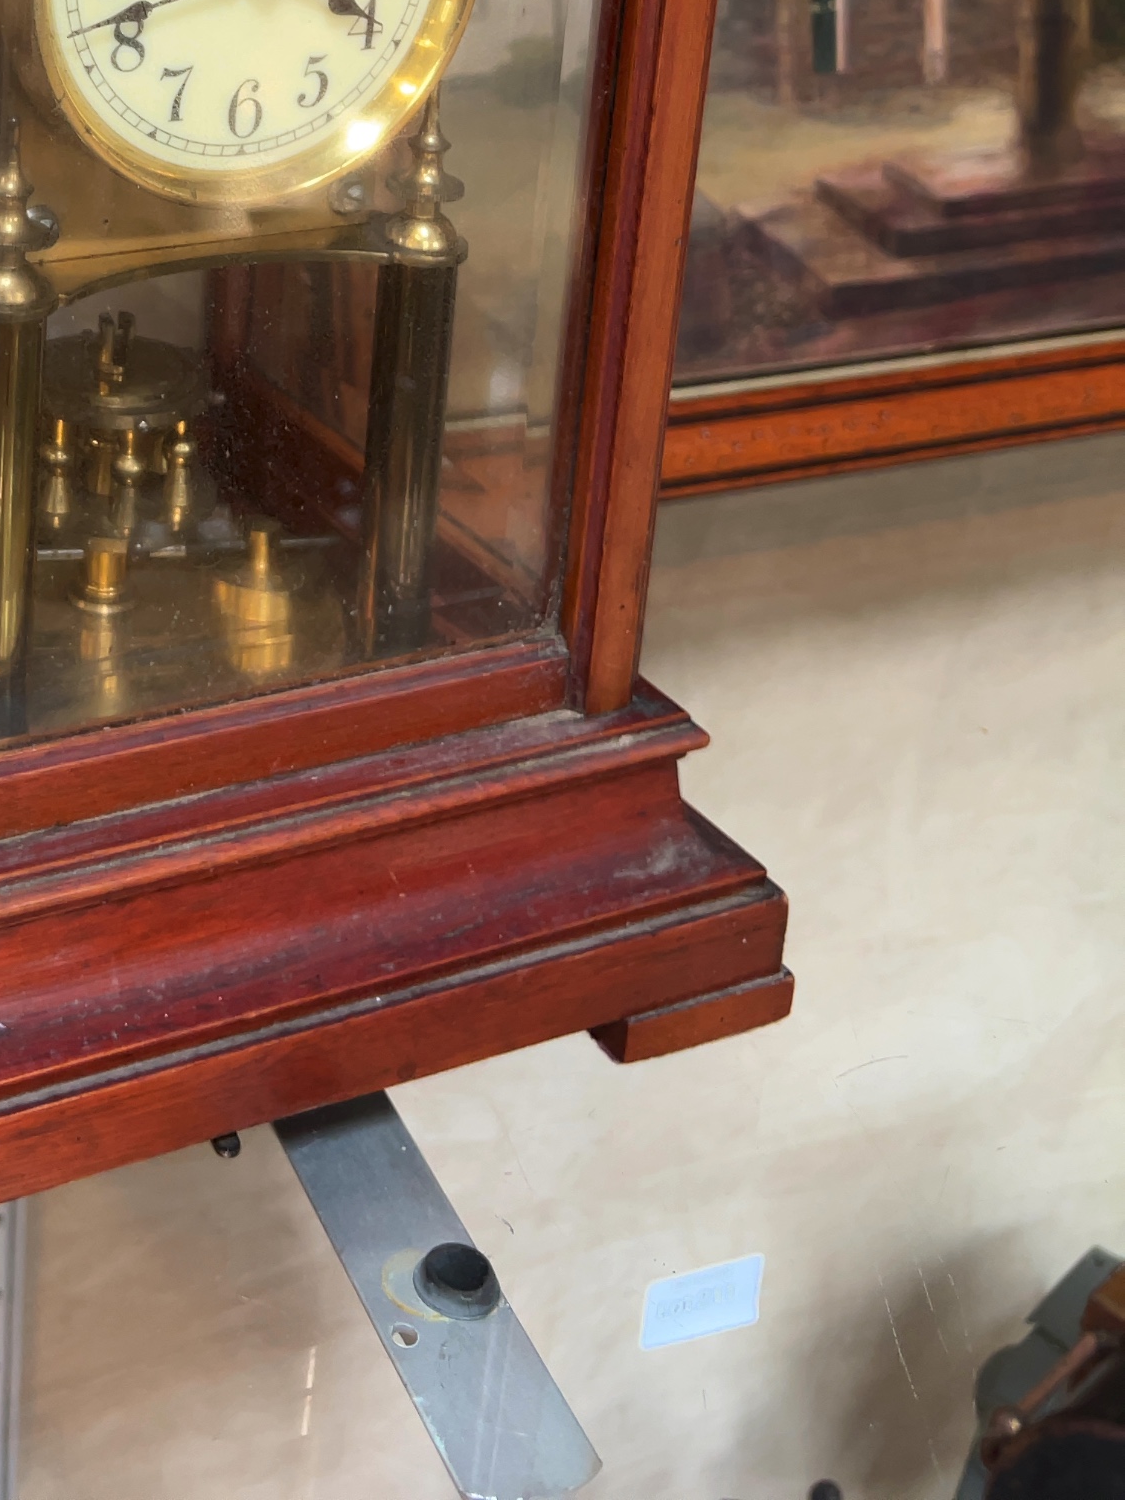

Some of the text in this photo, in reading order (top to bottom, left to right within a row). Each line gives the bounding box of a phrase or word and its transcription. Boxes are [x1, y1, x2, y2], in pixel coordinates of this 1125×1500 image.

[111, 7, 147, 72] 8
[161, 66, 194, 122] 7
[229, 79, 261, 139] 6
[297, 55, 327, 108] 5
